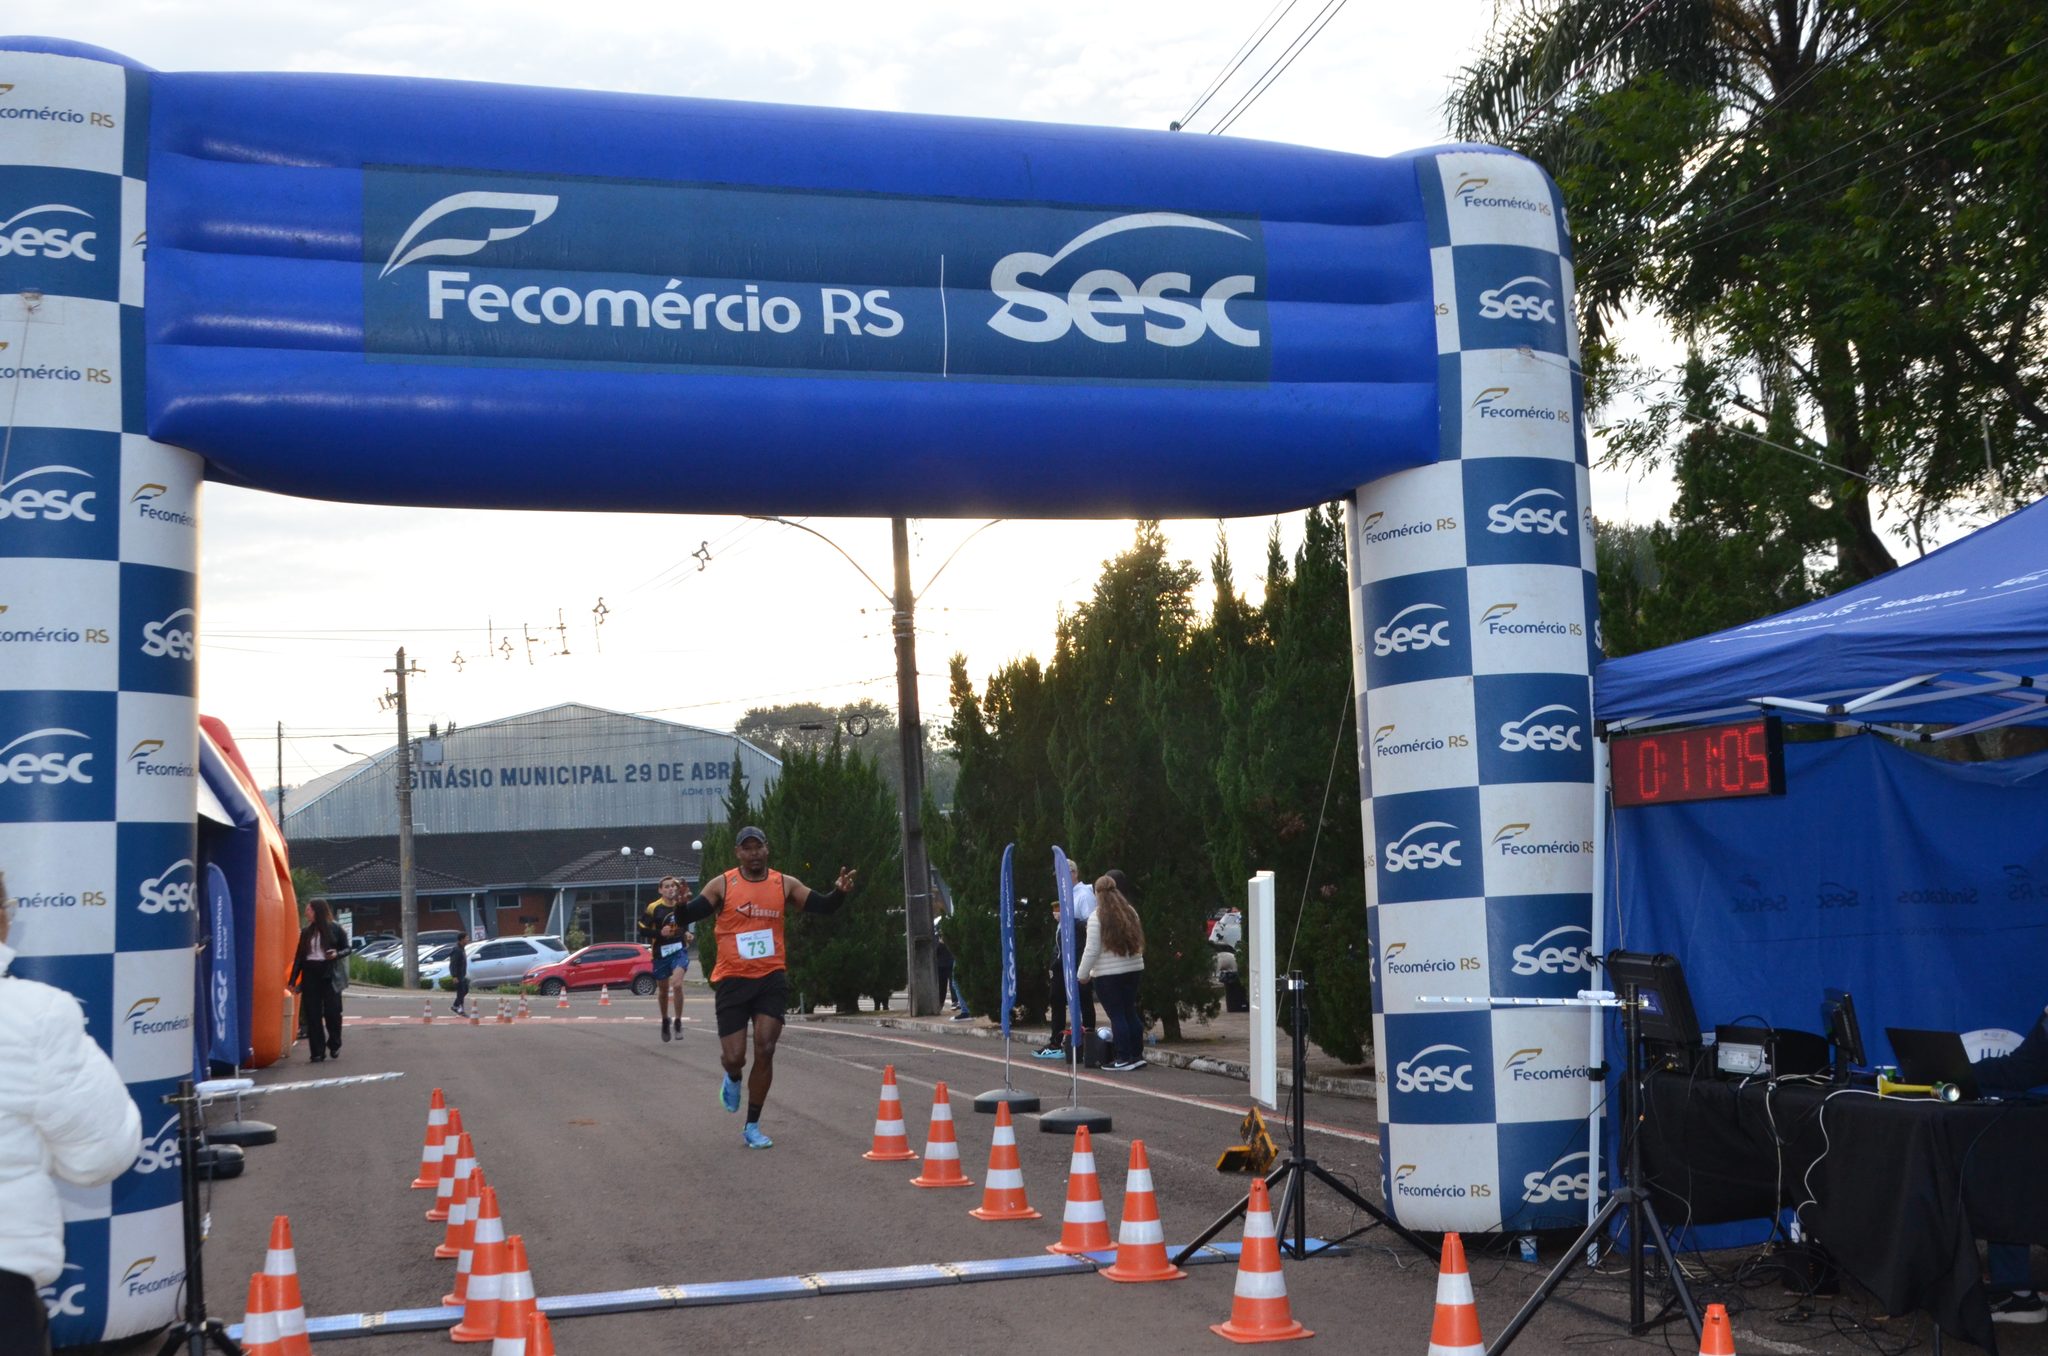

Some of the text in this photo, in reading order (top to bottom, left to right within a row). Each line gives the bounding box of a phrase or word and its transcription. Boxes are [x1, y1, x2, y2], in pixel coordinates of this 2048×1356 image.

[90, 111, 116, 129] RS
[1464, 194, 1551, 216] Fecomércio RS
[428, 270, 904, 338] Fecomércio RS
[86, 367, 112, 384] RS
[1480, 405, 1570, 423] Fecomércio RS
[1366, 517, 1457, 545] Fecomércio RS
[85, 628, 110, 644] RS
[1489, 620, 1567, 636] Fecomércio
[1569, 622, 1582, 636] RS
[140, 620, 197, 660] Ses
[1377, 734, 1470, 757] Fecomércio RS
[500, 765, 618, 787] MUNICIPAL
[625, 763, 652, 783] 29
[658, 763, 684, 782] DE
[1501, 841, 1580, 855] Fecomércio
[82, 891, 107, 906] RS
[747, 940, 767, 957] 73
[1388, 957, 1481, 974] Fecomércio RS
[1398, 1183, 1491, 1198] Fecomércio RS
